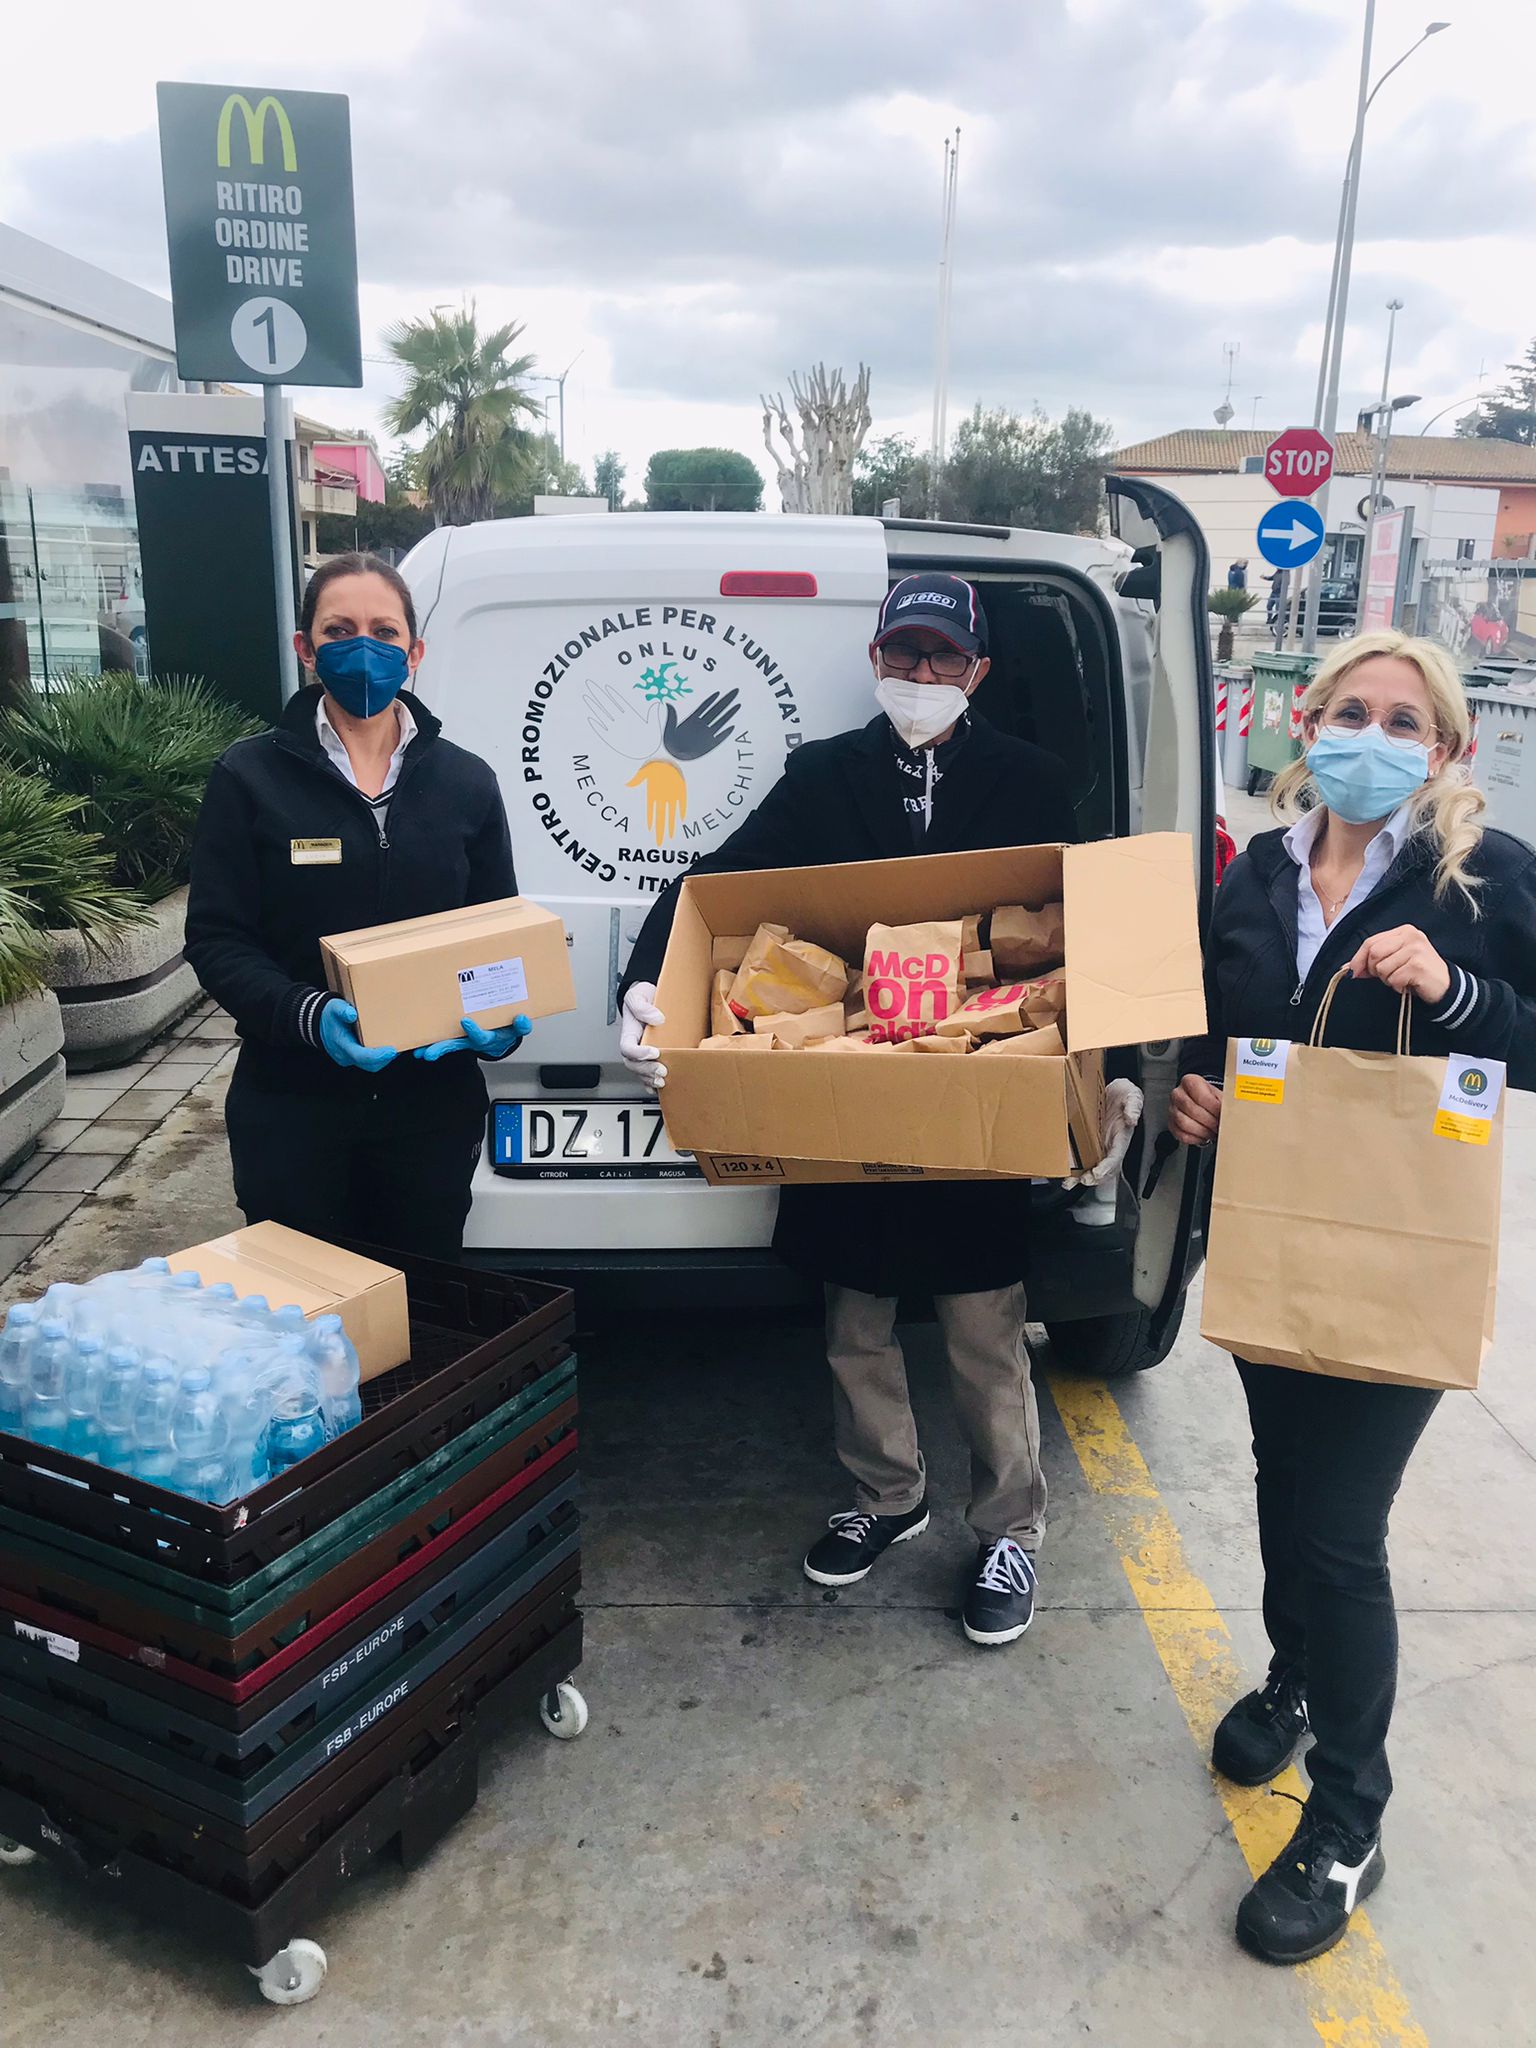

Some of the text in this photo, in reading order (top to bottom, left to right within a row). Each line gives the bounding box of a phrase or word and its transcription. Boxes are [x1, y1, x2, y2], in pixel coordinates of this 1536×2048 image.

[216, 181, 303, 215] RITIRO
[215, 217, 309, 251] ORDINE
[226, 255, 303, 287] DRIVE
[253, 306, 277, 364] 1
[1268, 449, 1330, 476] STOP
[663, 606, 717, 634] PER
[617, 642, 717, 672] ONLUS
[521, 607, 652, 783] PROMOZIONALE
[572, 754, 630, 833] MECCA
[682, 730, 754, 839] MELCHITA
[532, 792, 617, 882] CENTRO
[618, 848, 702, 865] RAGUSA
[638, 875, 680, 893] ITA
[867, 950, 950, 980] McD
[867, 978, 948, 1021] on
[1243, 1058, 1279, 1070] McDelivery
[1448, 1094, 1489, 1111] McDelivery
[529, 1109, 589, 1158] DZ
[721, 1160, 775, 1173] 120 x 4
[322, 1616, 406, 1689] FSB-EUROPE
[326, 1680, 410, 1756] FSB-EUROPE
